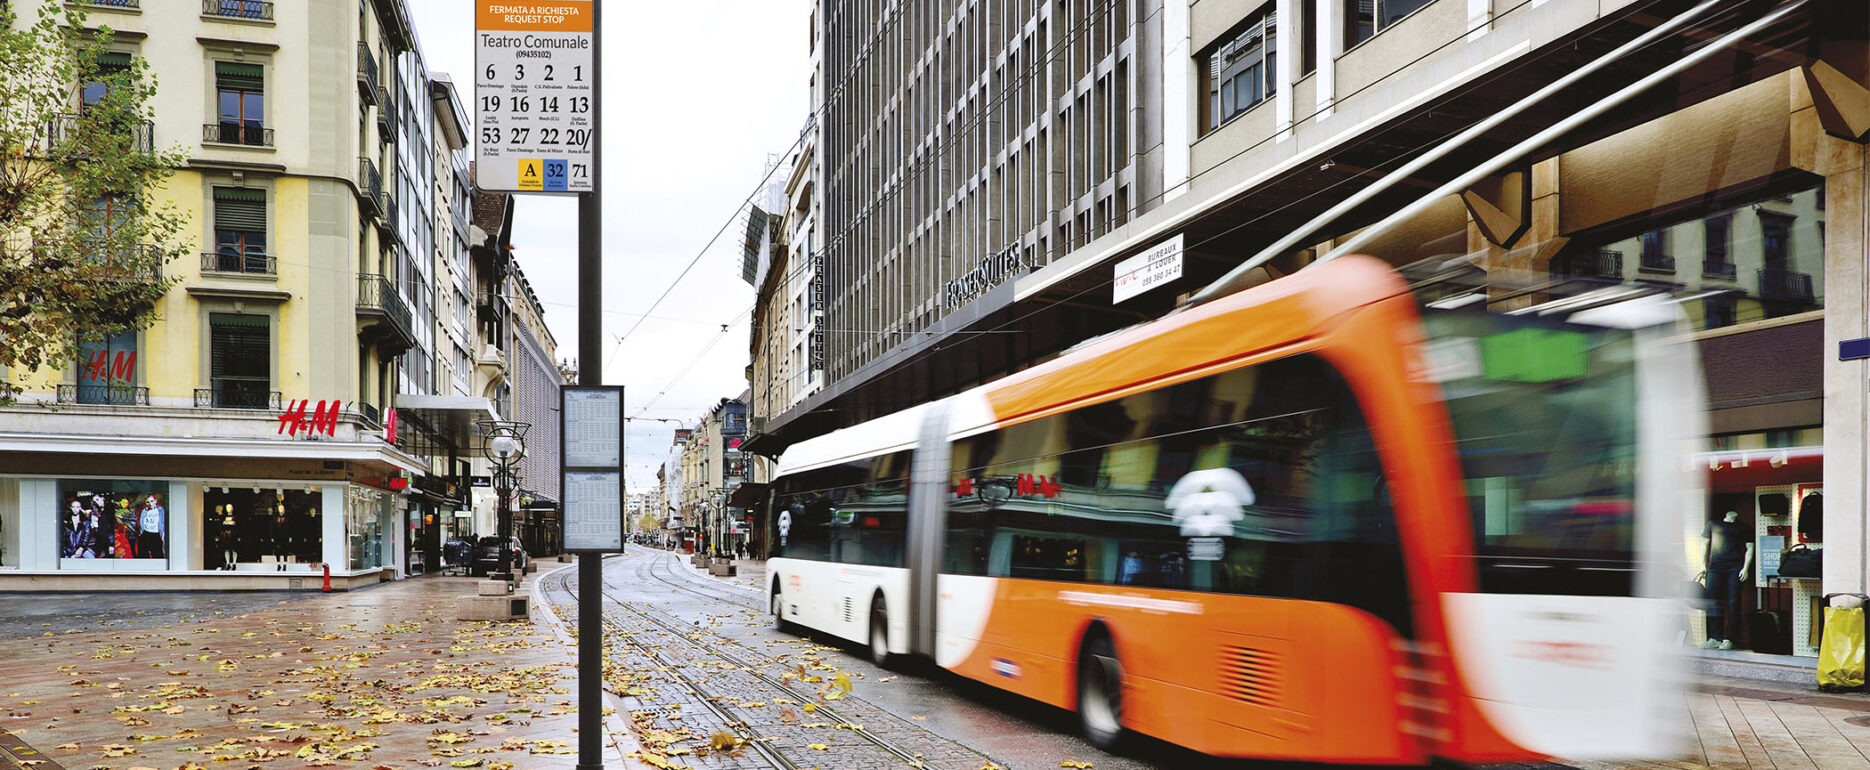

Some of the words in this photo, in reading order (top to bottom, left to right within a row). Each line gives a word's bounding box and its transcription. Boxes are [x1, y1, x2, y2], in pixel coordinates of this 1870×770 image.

[489, 5, 528, 14] FERMATA
[537, 7, 579, 15] RICHIESTA
[504, 15, 541, 24] REQUEST
[543, 15, 564, 23] STOP
[481, 34, 521, 48] Teatro
[524, 34, 588, 49] Comunale
[516, 50, 552, 60] (09435102)
[486, 64, 495, 80] 6
[515, 64, 524, 80] 3
[544, 64, 553, 81] 2
[574, 65, 582, 81] 1
[482, 96, 500, 112] 19
[511, 96, 529, 112] 16
[540, 96, 559, 112] 14
[570, 96, 588, 113] 13
[482, 128, 500, 143] 53
[511, 128, 530, 144] 27
[540, 128, 559, 144] 22
[566, 129, 592, 150] 20/
[524, 163, 536, 176] A
[547, 164, 563, 177] 32
[572, 164, 587, 178] 71
[1148, 244, 1177, 263] BUREAUX
[1155, 254, 1176, 269] LOUER
[815, 257, 823, 311] FRASER
[815, 316, 823, 370] SUITES
[81, 349, 137, 383] H&M
[278, 399, 341, 437] H&M
